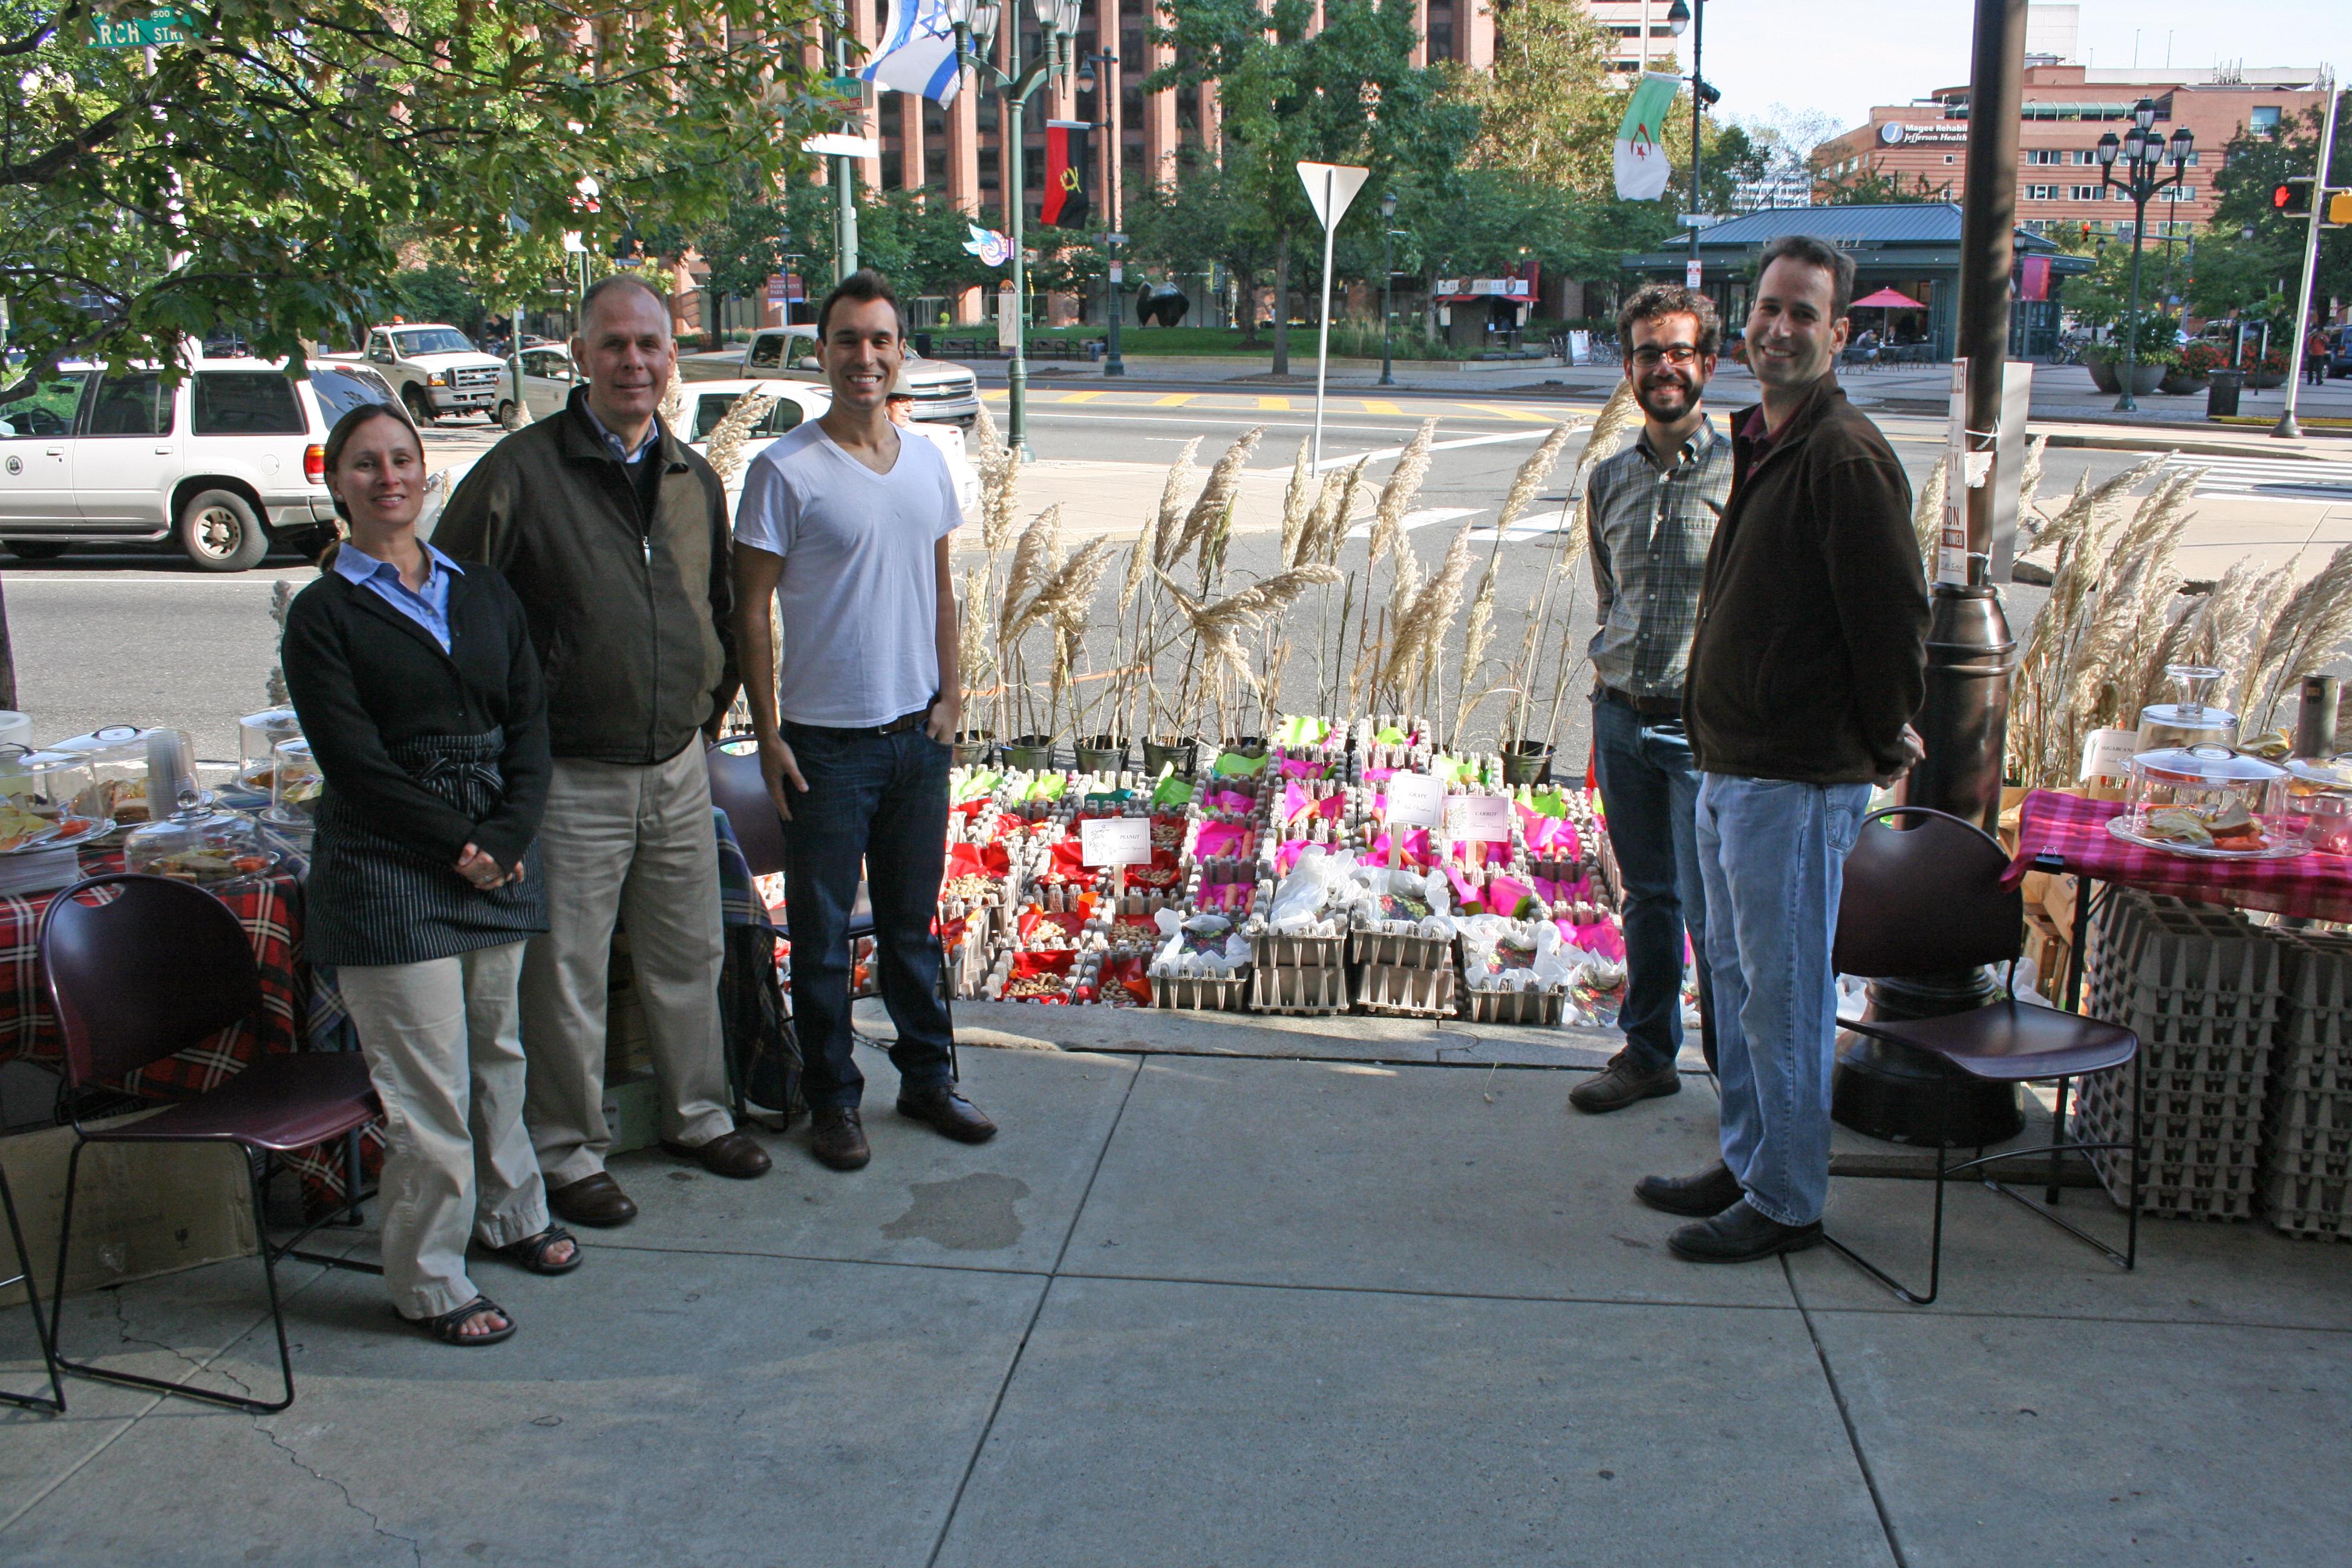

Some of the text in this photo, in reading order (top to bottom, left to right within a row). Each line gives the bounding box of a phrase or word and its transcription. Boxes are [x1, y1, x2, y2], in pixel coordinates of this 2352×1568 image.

[151, 10, 170, 18] 500
[154, 27, 184, 41] STR
[1905, 124, 1968, 132] Magee Rehabil
[1903, 133, 1968, 143] Jefferson Health
[1830, 233, 1867, 249] RET
[1945, 531, 1963, 546] TOWED
